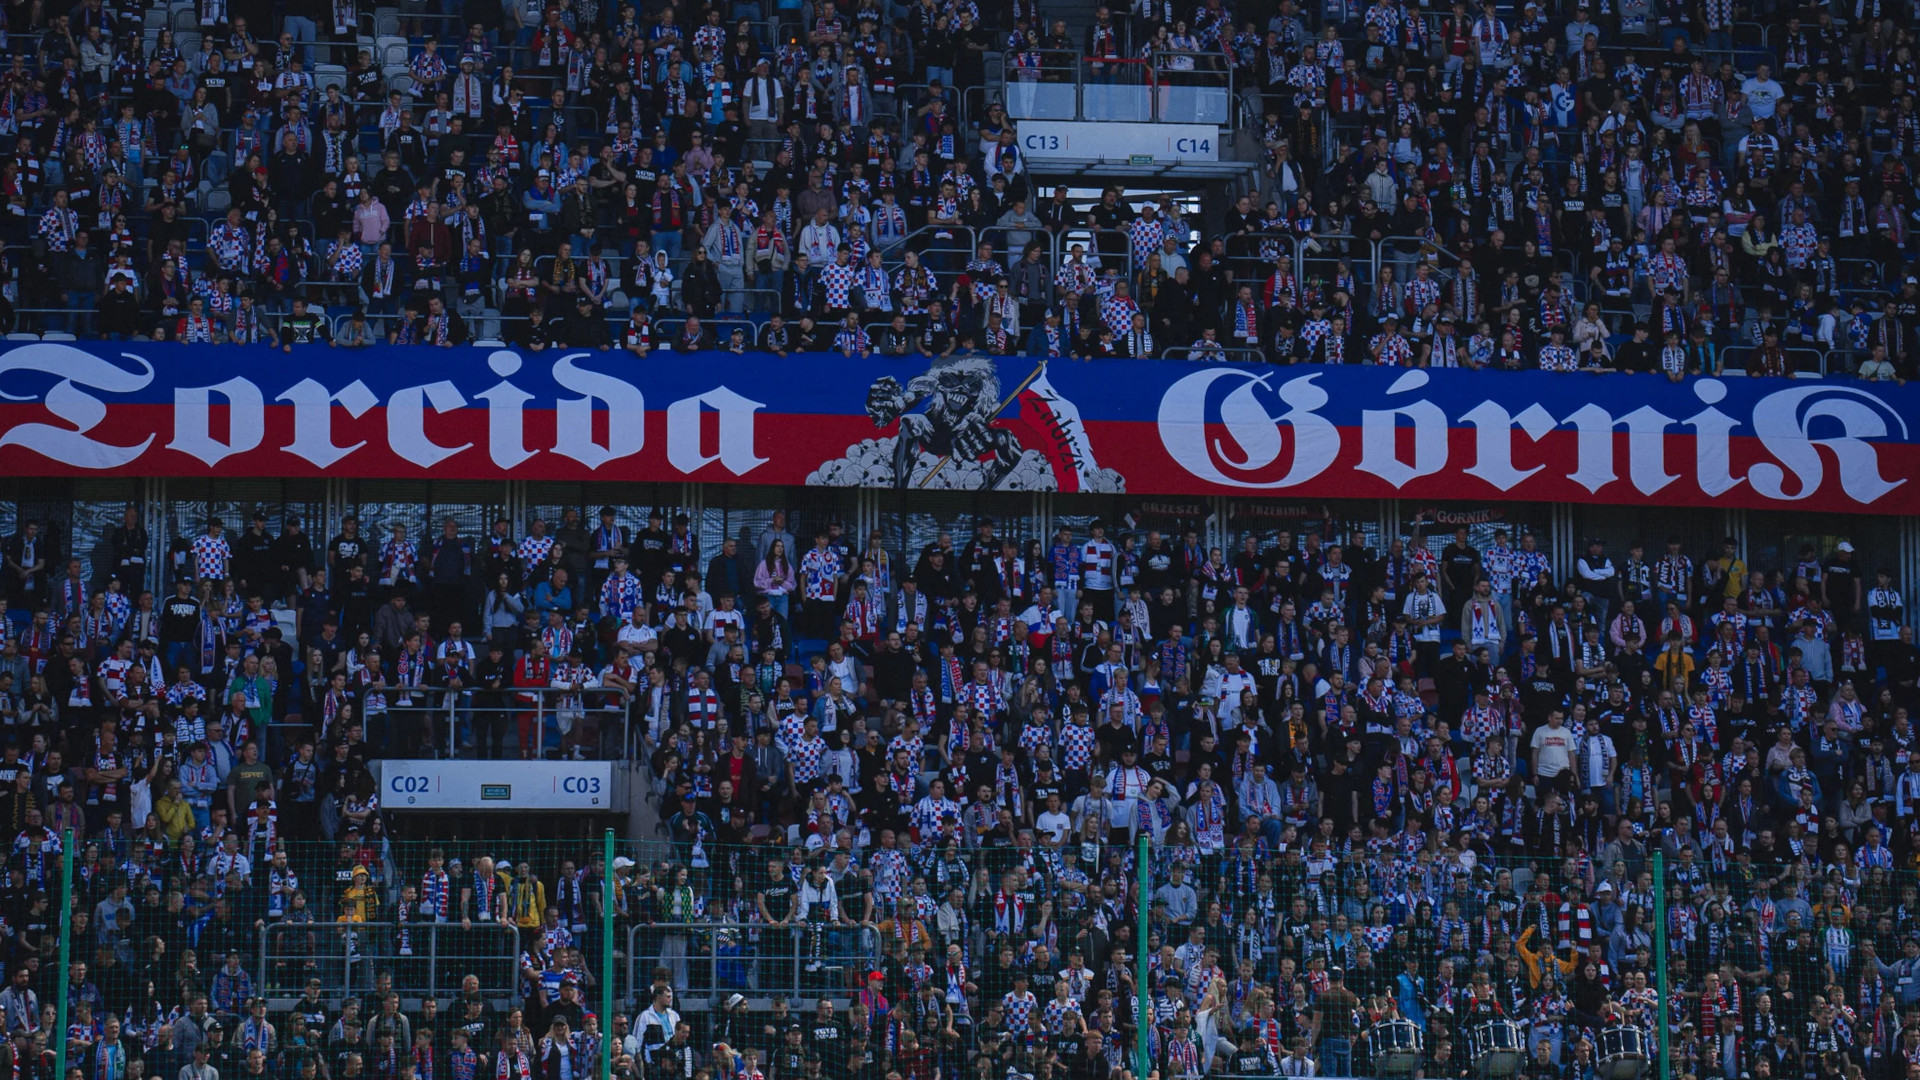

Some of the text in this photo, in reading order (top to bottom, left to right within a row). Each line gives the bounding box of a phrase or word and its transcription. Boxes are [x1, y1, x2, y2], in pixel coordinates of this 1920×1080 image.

[1026, 135, 1059, 150] C13
[1176, 138, 1210, 153] C14
[0, 343, 768, 476] Torcida
[1027, 389, 1085, 472] Zabrze
[391, 776, 429, 793] C02
[563, 777, 600, 793] C03
